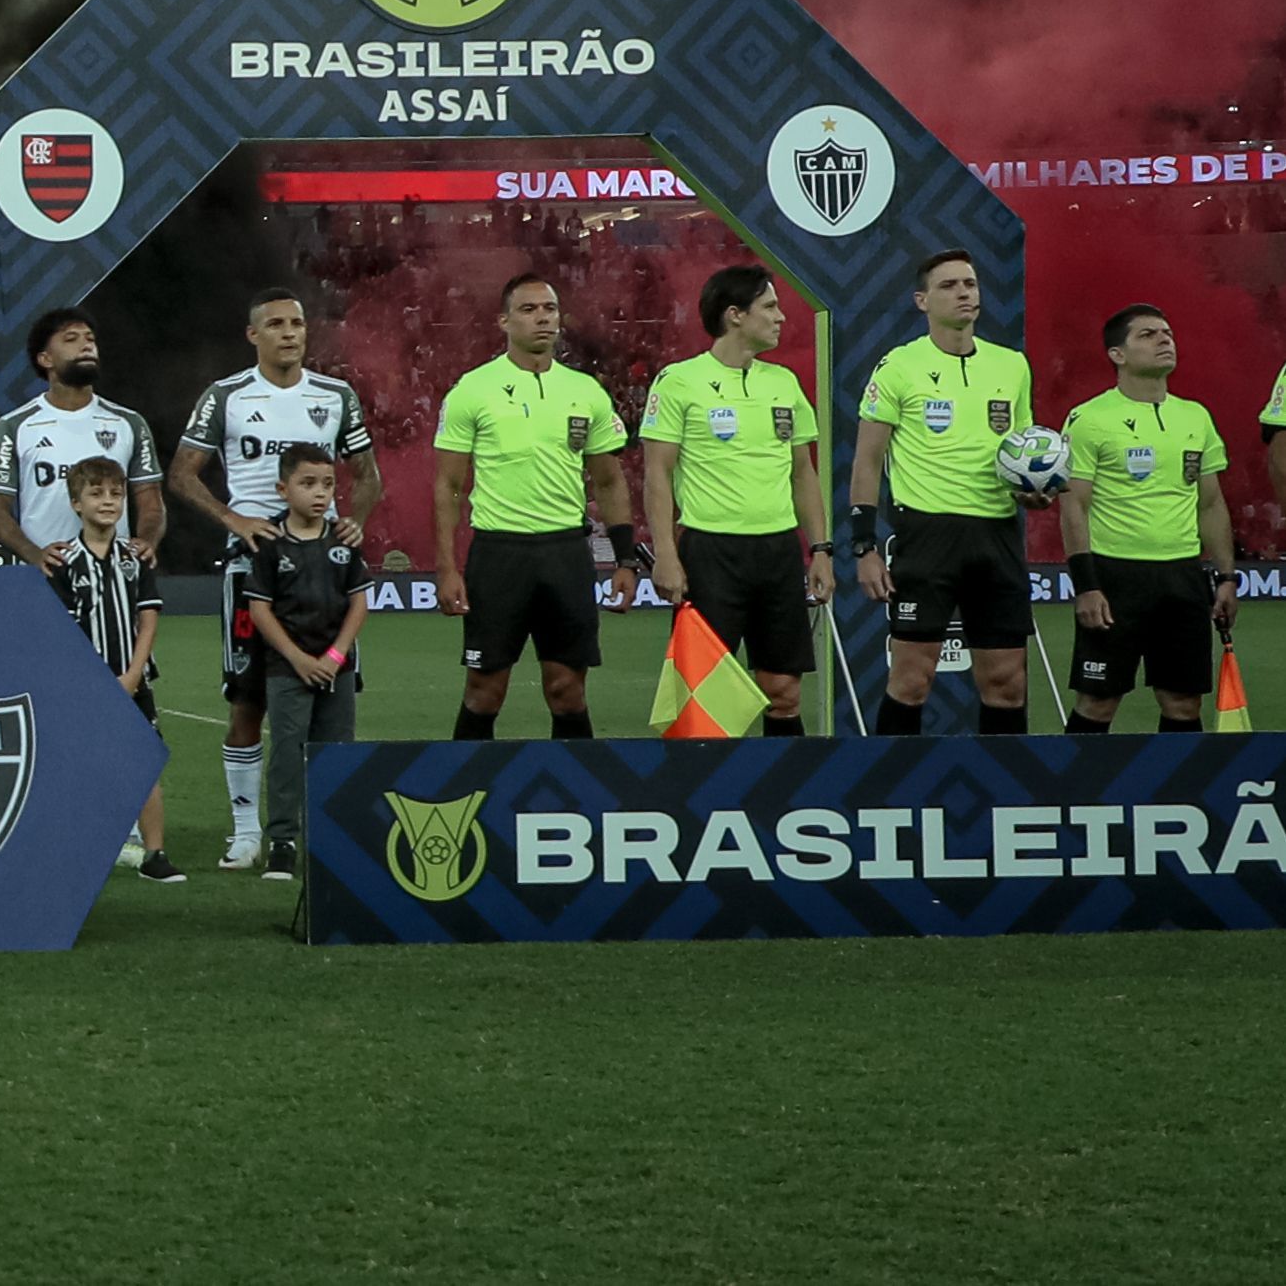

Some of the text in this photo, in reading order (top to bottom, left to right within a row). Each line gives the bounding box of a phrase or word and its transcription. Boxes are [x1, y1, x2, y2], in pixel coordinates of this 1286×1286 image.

[231, 29, 655, 78] BRASILEIRÃO
[378, 87, 509, 122] ASSAÍ
[806, 155, 857, 170] CAM
[967, 154, 1179, 189] MILHARES
[1191, 152, 1248, 183] DE
[497, 171, 577, 199] SUA
[926, 400, 952, 411] FIFA
[0, 434, 14, 469] MRV
[1128, 448, 1152, 458] FIFA
[1083, 661, 1107, 673] CBF
[516, 781, 1286, 884] BRASILEIRÃ
